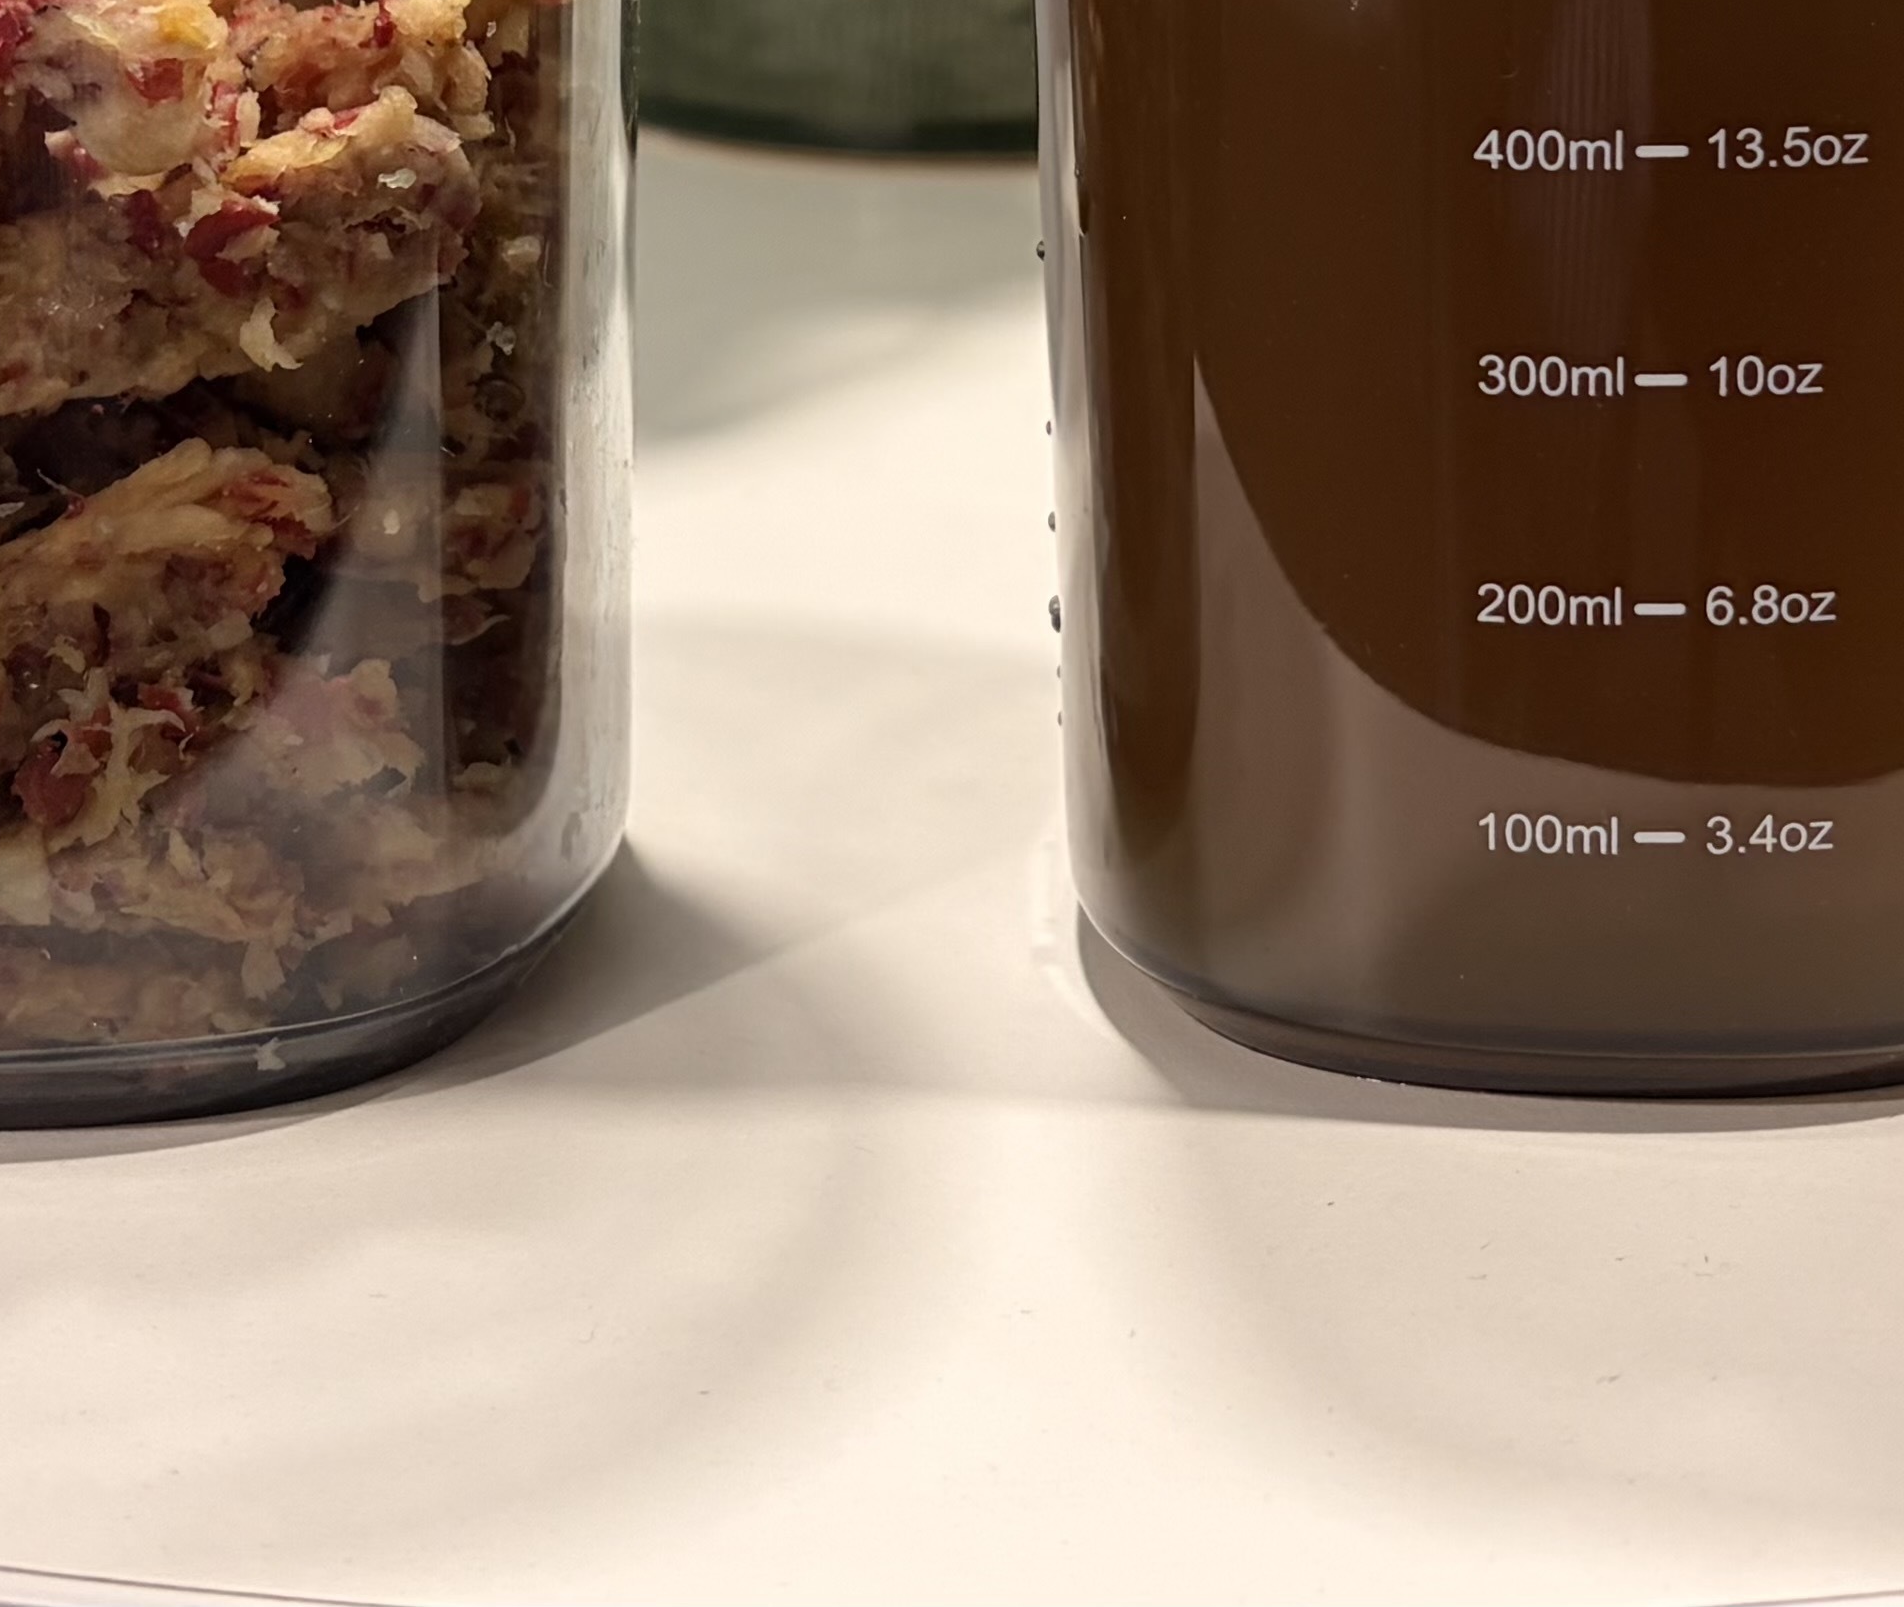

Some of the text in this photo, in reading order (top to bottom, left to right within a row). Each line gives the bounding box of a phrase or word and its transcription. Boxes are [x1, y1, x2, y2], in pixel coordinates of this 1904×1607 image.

[1472, 126, 1869, 170] 400ml 13.5oz
[1478, 354, 1824, 396] 300ml 10oz
[1477, 583, 1837, 626] 200ml 6.8oz
[1478, 812, 1834, 855] 100ml 3.4oz
